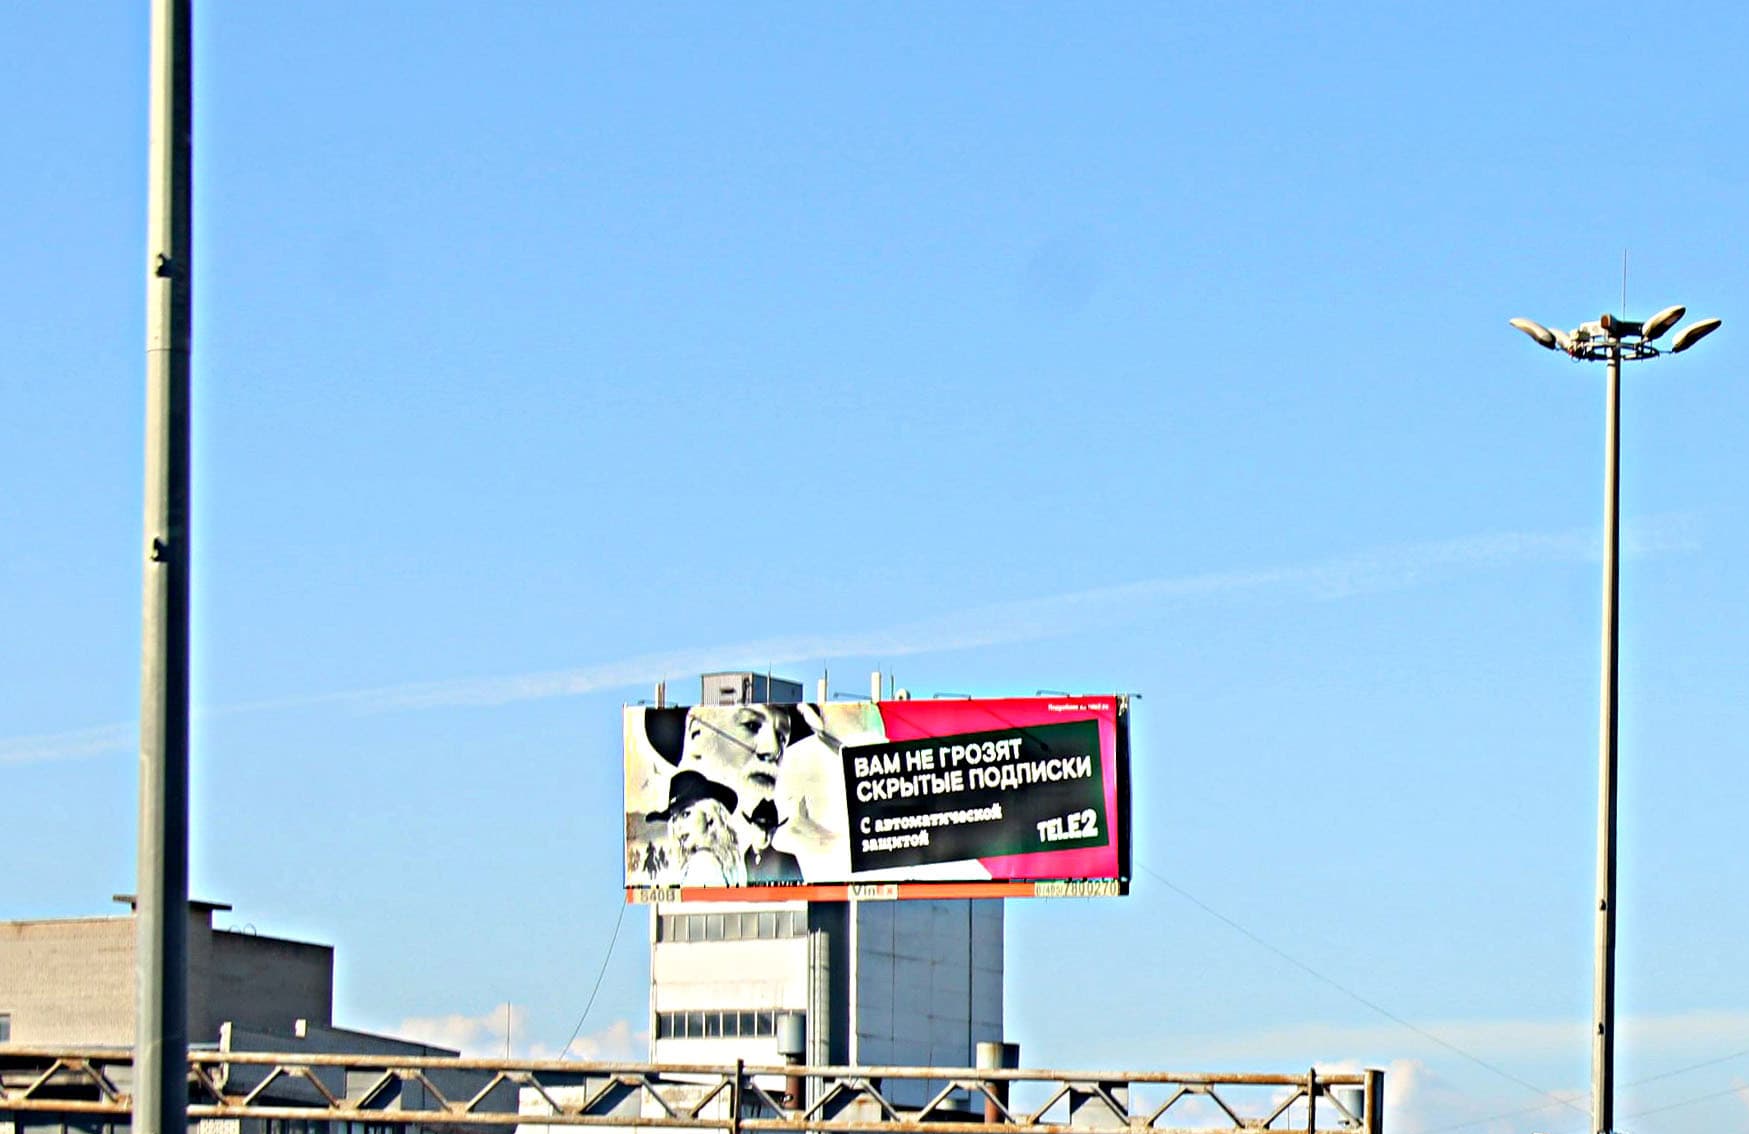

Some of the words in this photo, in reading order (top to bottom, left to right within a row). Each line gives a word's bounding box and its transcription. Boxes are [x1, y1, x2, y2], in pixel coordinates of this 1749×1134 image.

[854, 751, 901, 778] ВАМ
[905, 749, 935, 772] НЕ
[940, 738, 1022, 768] ГРОЗЯТ
[856, 771, 964, 802] СКРЫТЫЕ
[969, 755, 1092, 791] ПОДПИСКИ
[875, 803, 1003, 831] автоматической
[1036, 809, 1098, 842] TELE2
[862, 831, 929, 852] защитой
